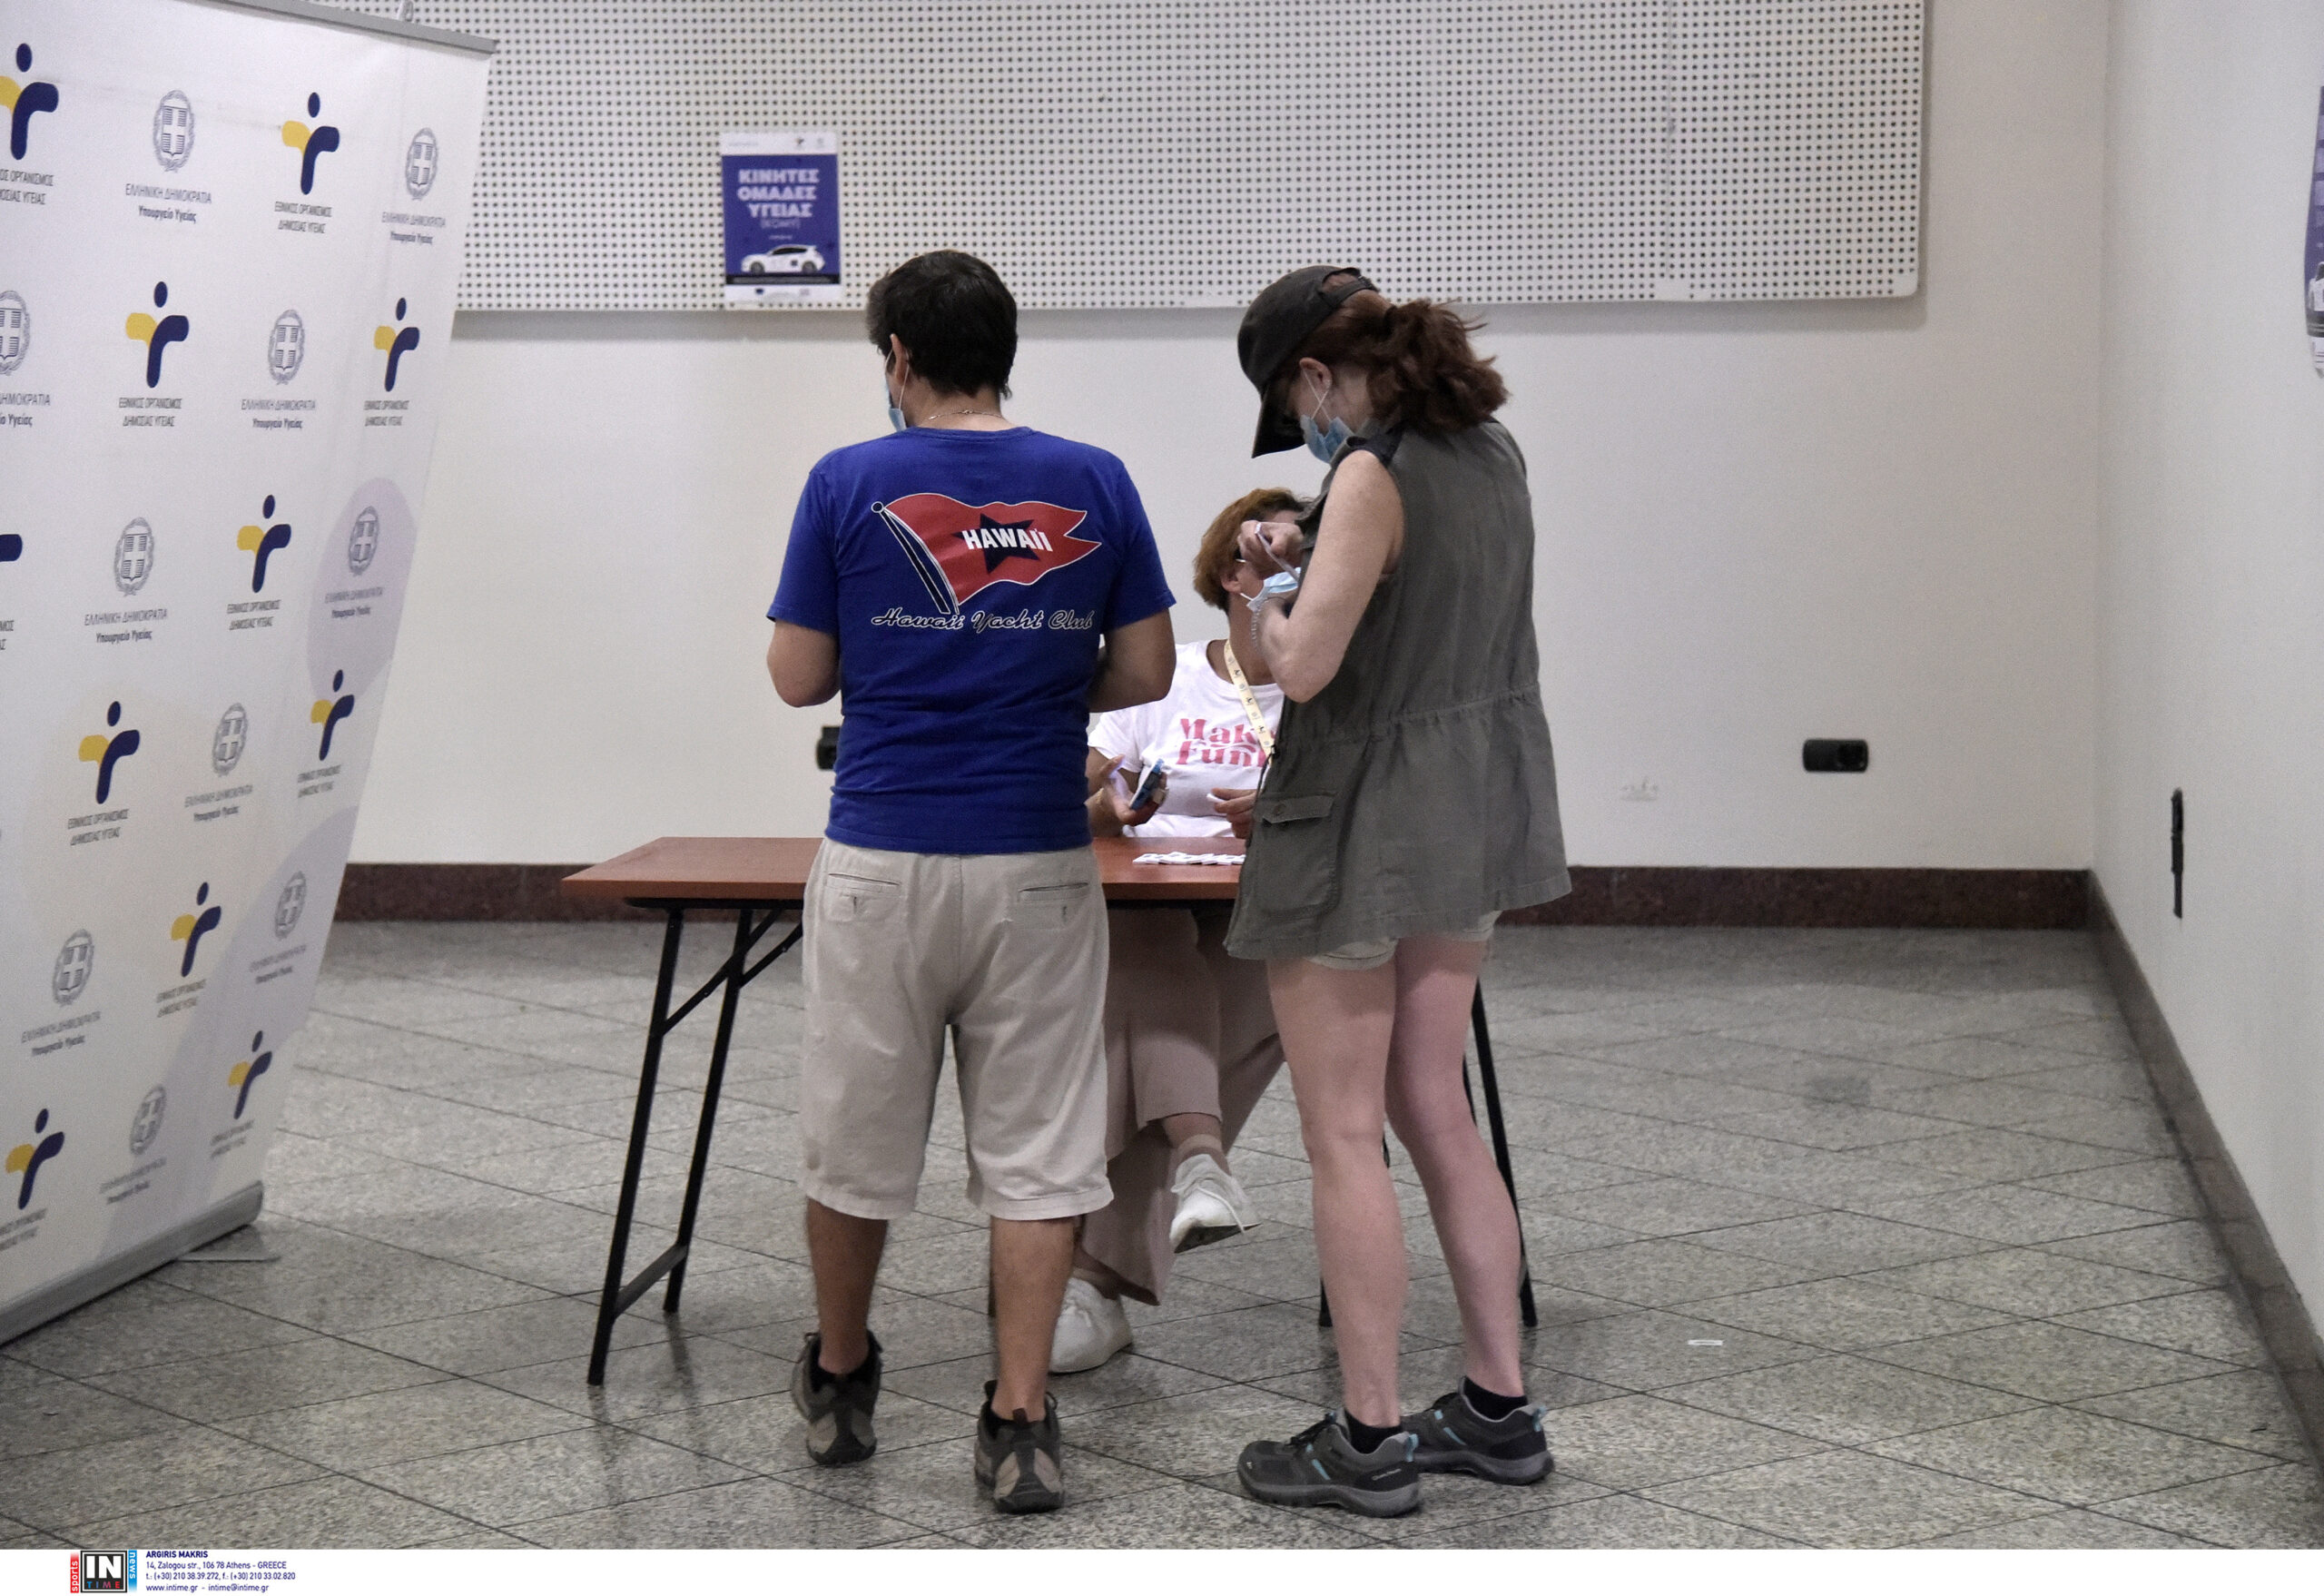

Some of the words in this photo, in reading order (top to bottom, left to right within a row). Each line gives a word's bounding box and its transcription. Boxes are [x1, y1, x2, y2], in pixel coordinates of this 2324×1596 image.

[738, 169, 820, 183] ΚΙΝΗΤΕΣ
[736, 185, 816, 201] ΟΜΑΔΕΣ
[747, 202, 812, 218] ΥΓΕΙΑΣ
[0, 392, 50, 406] ΗΜΟΚΡΑΤΙΑ
[8, 412, 33, 428] Υγείας
[872, 606, 965, 629] Hawaii
[971, 608, 1044, 634] Yacht
[1049, 609, 1095, 630] Club
[1180, 718, 1275, 744] Mak
